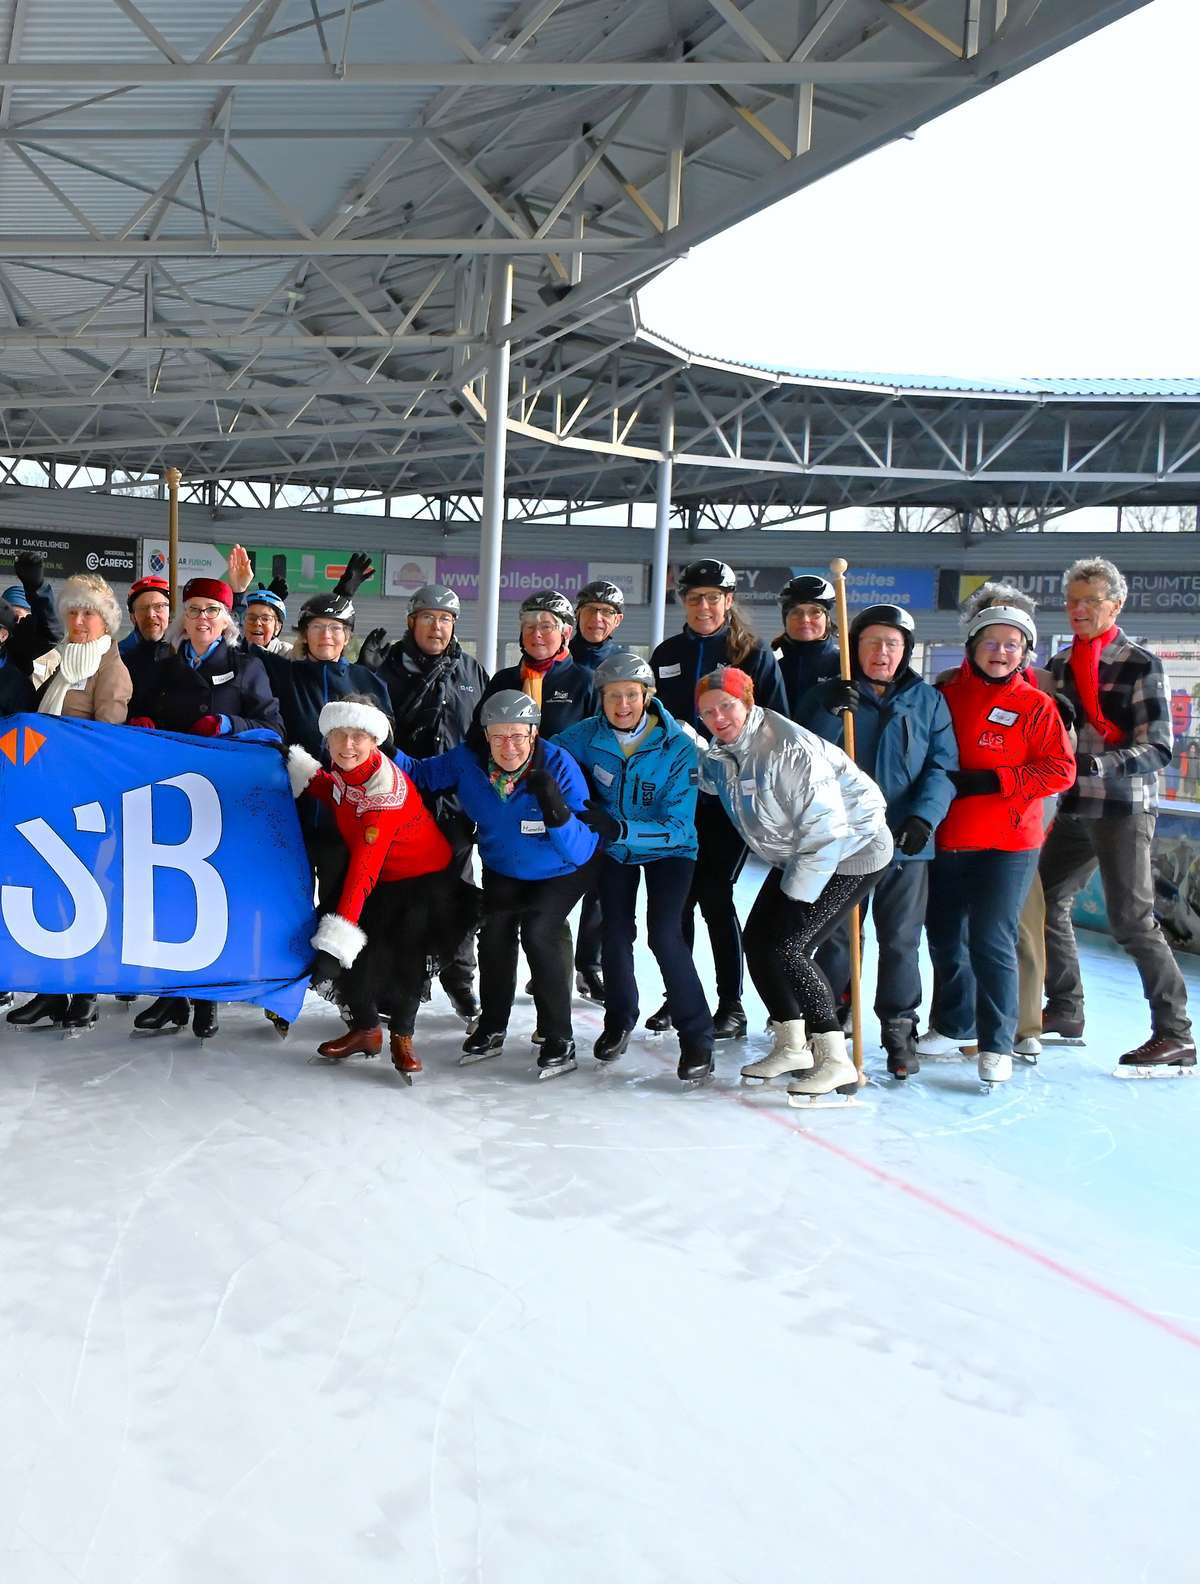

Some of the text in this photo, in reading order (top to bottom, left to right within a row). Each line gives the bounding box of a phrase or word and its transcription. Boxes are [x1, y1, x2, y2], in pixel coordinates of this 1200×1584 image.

[22, 539, 70, 550] DAKVEILIGHEID
[100, 558, 134, 569] CAREFOS
[1156, 592, 1200, 607] GRO
